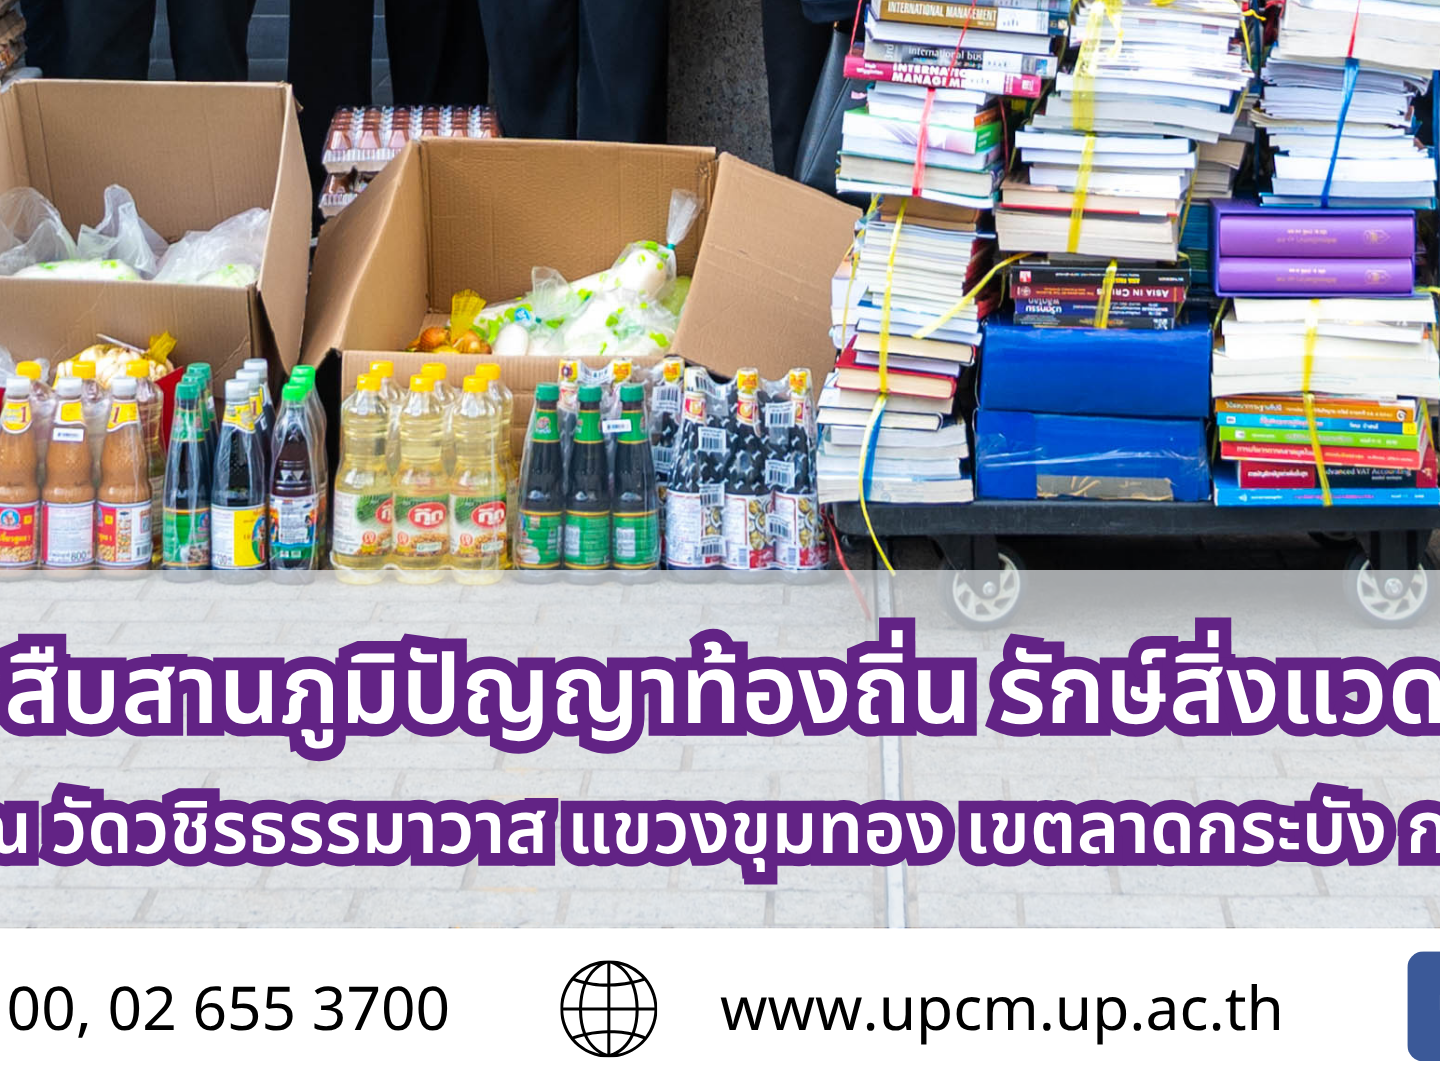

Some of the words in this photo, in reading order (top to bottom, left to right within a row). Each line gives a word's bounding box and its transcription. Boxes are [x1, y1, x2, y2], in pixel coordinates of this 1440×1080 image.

[887, 1, 945, 17] INTERNATIONAL
[908, 46, 965, 60] international
[1132, 289, 1143, 297] IN
[1146, 289, 1169, 298] ASIA
[1324, 468, 1355, 476] dvanced
[1356, 468, 1370, 476] VAT
